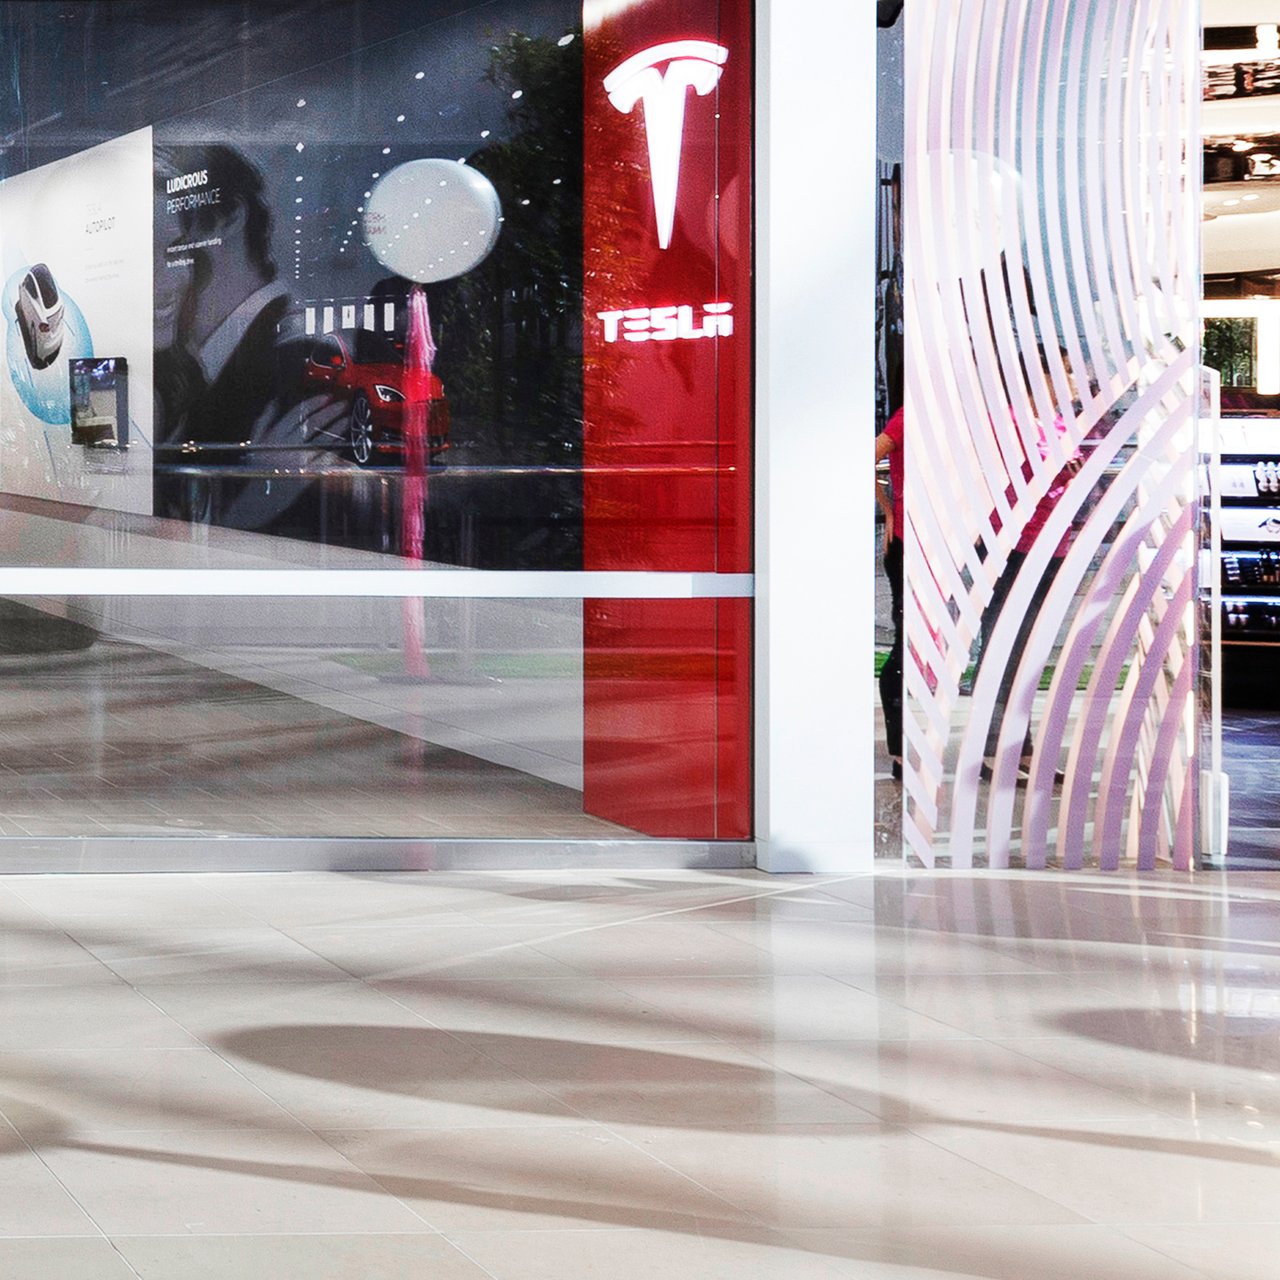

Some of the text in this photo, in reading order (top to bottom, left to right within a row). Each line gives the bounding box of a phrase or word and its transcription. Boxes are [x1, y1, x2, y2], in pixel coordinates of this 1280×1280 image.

[166, 169, 208, 194] LUDICROUS
[166, 188, 221, 215] PERFORMANCE
[596, 301, 734, 343] TESLA
